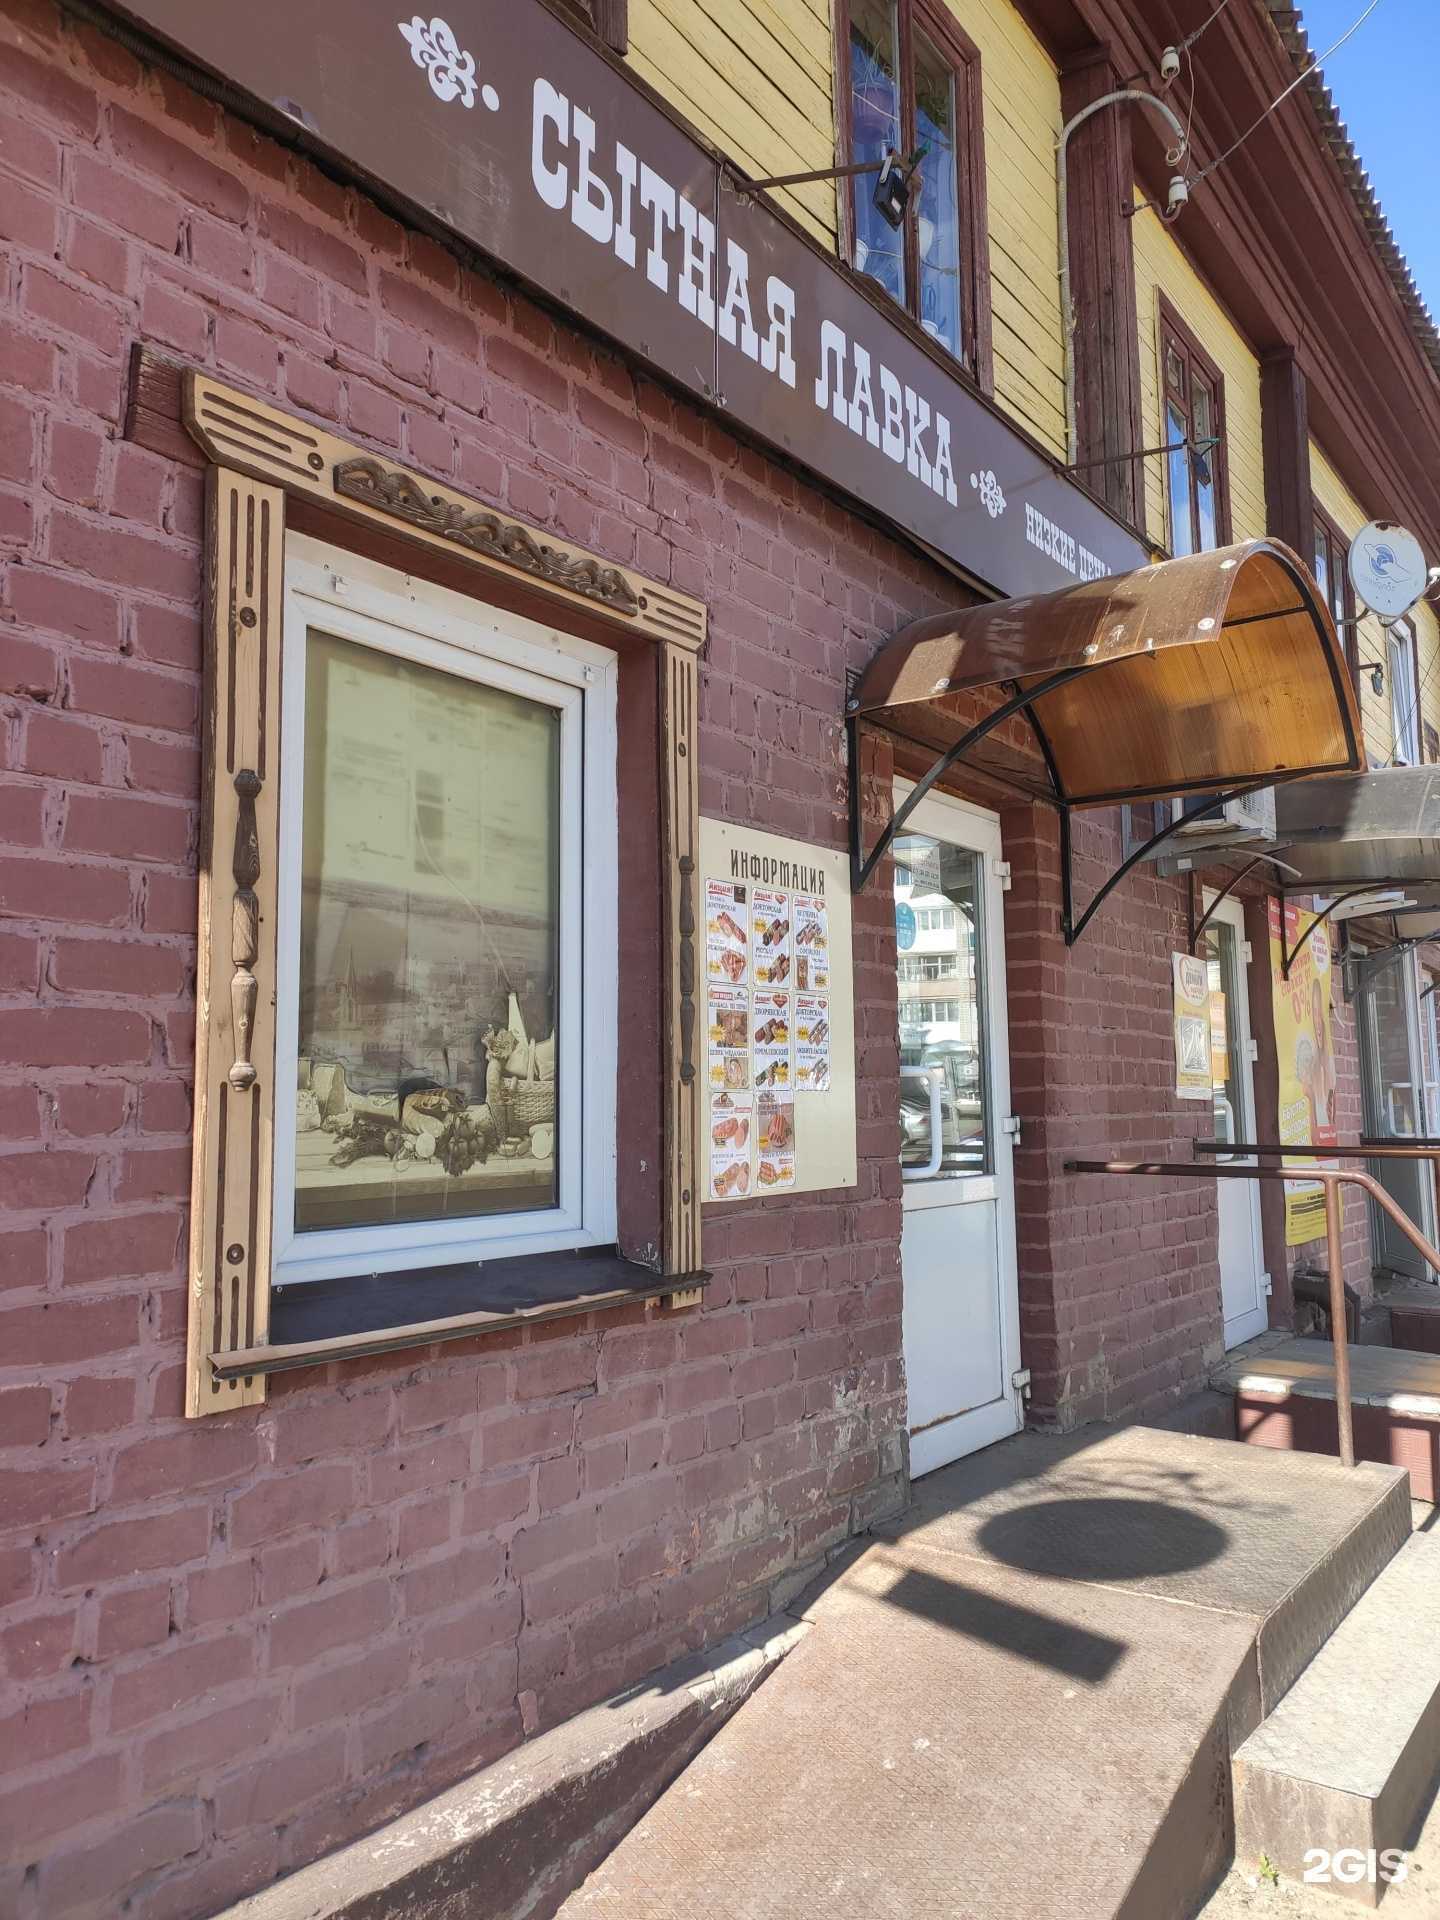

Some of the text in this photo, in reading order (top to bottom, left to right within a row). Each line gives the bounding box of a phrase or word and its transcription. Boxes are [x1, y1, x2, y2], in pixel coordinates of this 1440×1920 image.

[532, 77, 958, 507] СЫТНАЯ ЛАВКА
[1025, 502, 1111, 583] НИЗКИЕ ЦЕН
[730, 849, 825, 895] ИНФОРМАЦИЯ
